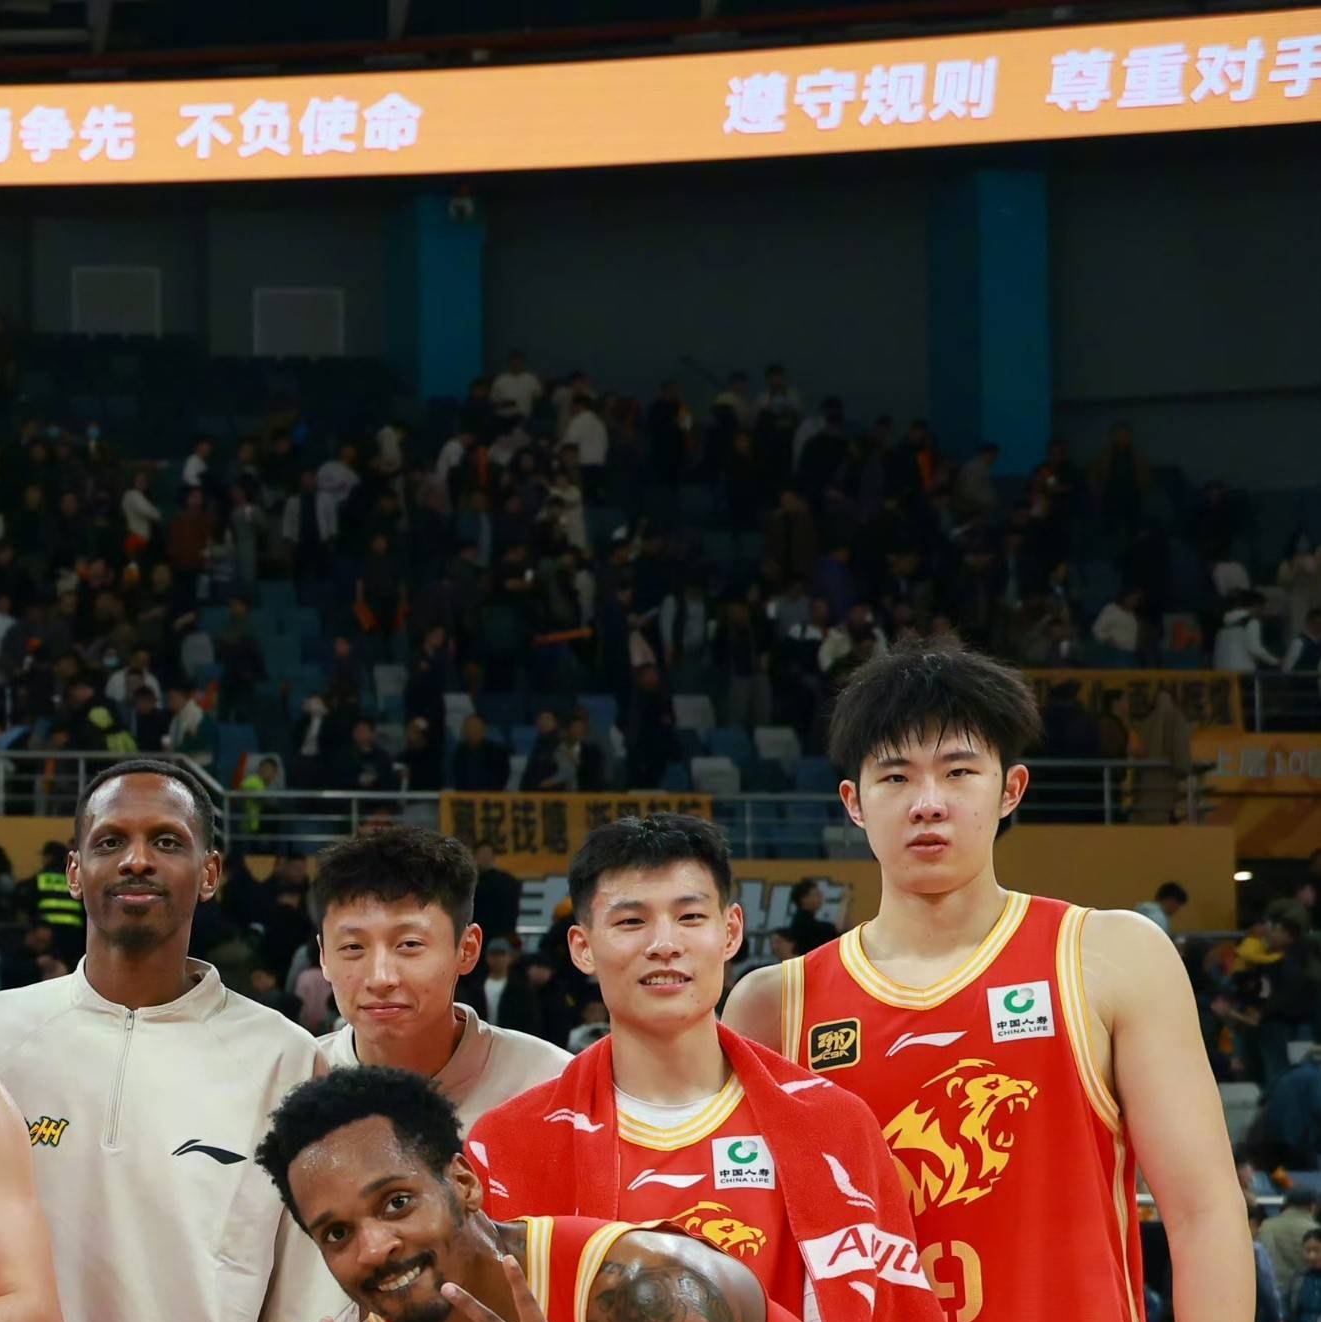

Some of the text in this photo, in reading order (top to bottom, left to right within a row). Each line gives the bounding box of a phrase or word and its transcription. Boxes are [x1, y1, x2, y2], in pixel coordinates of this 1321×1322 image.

[722, 56, 998, 135] 遵守规则
[176, 92, 424, 158] 不负使命
[997, 1016, 1048, 1030] 中国人寿
[998, 1029, 1026, 1037] CHINA
[719, 1168, 770, 1178] 中国人寿
